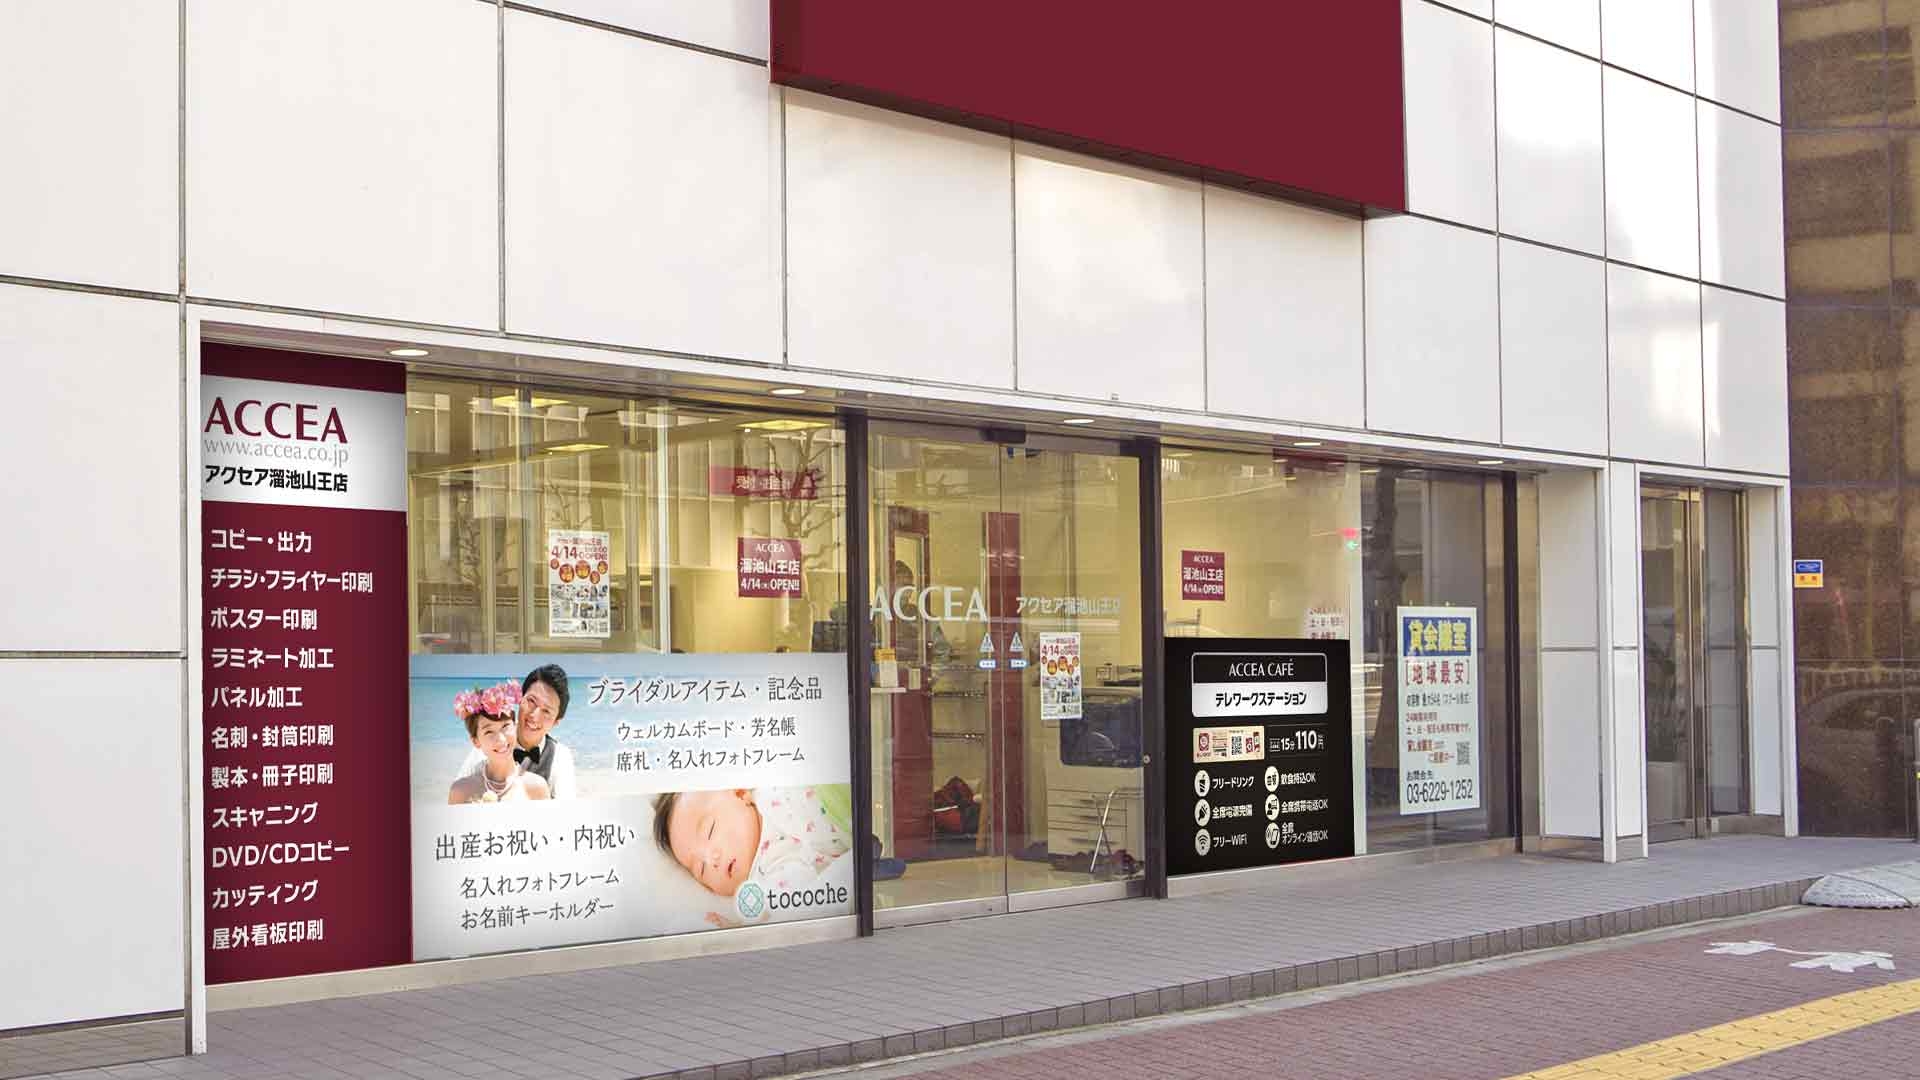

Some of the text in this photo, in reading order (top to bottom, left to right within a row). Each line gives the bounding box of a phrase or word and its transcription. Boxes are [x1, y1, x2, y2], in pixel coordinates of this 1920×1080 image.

[204, 396, 348, 444] ACCEA
[204, 438, 349, 468] www.accea.co.jp
[204, 464, 349, 493] アクセア溜池山王店
[211, 528, 312, 553] コピー・出力
[756, 543, 785, 553] ACCEA
[211, 568, 373, 593] チラシ・フライヤー印刷
[869, 586, 988, 622] ACCEA
[210, 607, 318, 631] ポスター印刷
[210, 647, 334, 670] ラミネート加工
[1229, 658, 1294, 677] ACCEA CAFÉ
[211, 686, 303, 708] パネル加工
[590, 676, 822, 705] ブライダルアイテム・記念品
[1215, 692, 1307, 707] テレワークステーション
[211, 725, 334, 749] 名刺・封筒印刷
[617, 716, 796, 743] ウェルカムボード・芳名帳
[616, 747, 805, 772] 席札・名入れフォトフレーム
[211, 763, 334, 789] 製本・冊子印刷
[1212, 776, 1254, 789] フリードリンク
[1281, 772, 1317, 785] 飲食持込OK
[1407, 779, 1472, 804] 03-6229-1252
[212, 802, 319, 828] スキャニング
[212, 840, 350, 868] DVD/CDコピー
[435, 824, 635, 861] 出産お祝い・内祝い
[212, 879, 319, 909] カッティング
[460, 868, 620, 900] 名入れフォトフレーム
[767, 883, 848, 911] tocoche
[461, 900, 614, 931] お名前キーホルダー
[212, 918, 323, 950] 屋外看板印刷
